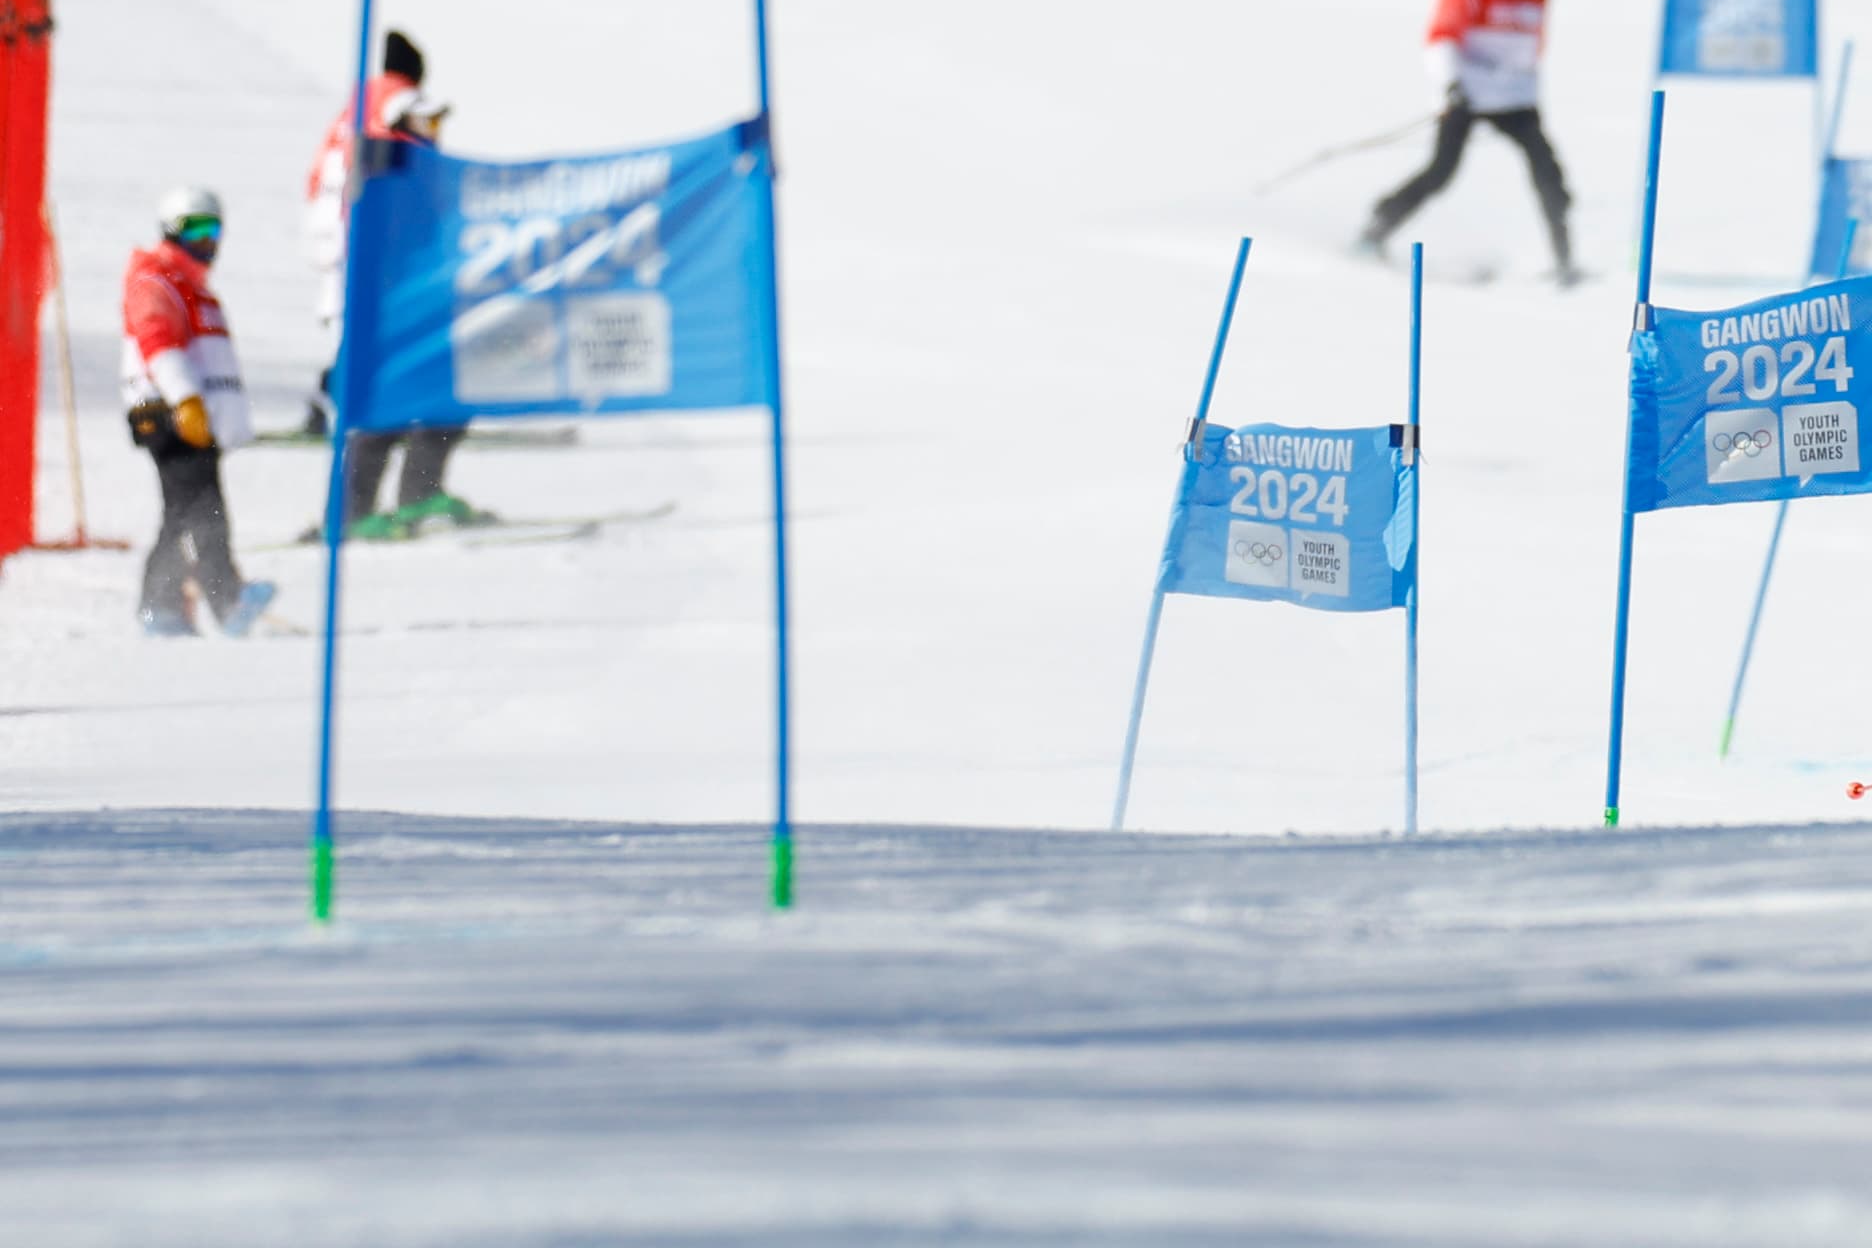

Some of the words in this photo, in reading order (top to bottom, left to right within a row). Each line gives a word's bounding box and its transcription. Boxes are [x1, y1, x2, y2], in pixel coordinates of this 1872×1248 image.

[456, 201, 668, 295] 2024
[1701, 293, 1850, 349] GANGWON
[1704, 336, 1854, 403] 2024
[1799, 414, 1840, 430] YOUTH
[1793, 429, 1848, 447] OLYMPIC
[1224, 434, 1354, 472] GANGWON
[1799, 445, 1844, 463] GAMES
[1229, 466, 1349, 526] 2024
[1303, 540, 1336, 556] YOUTH
[1297, 553, 1341, 571] OLYMPIC
[1302, 567, 1337, 585] GAMES
